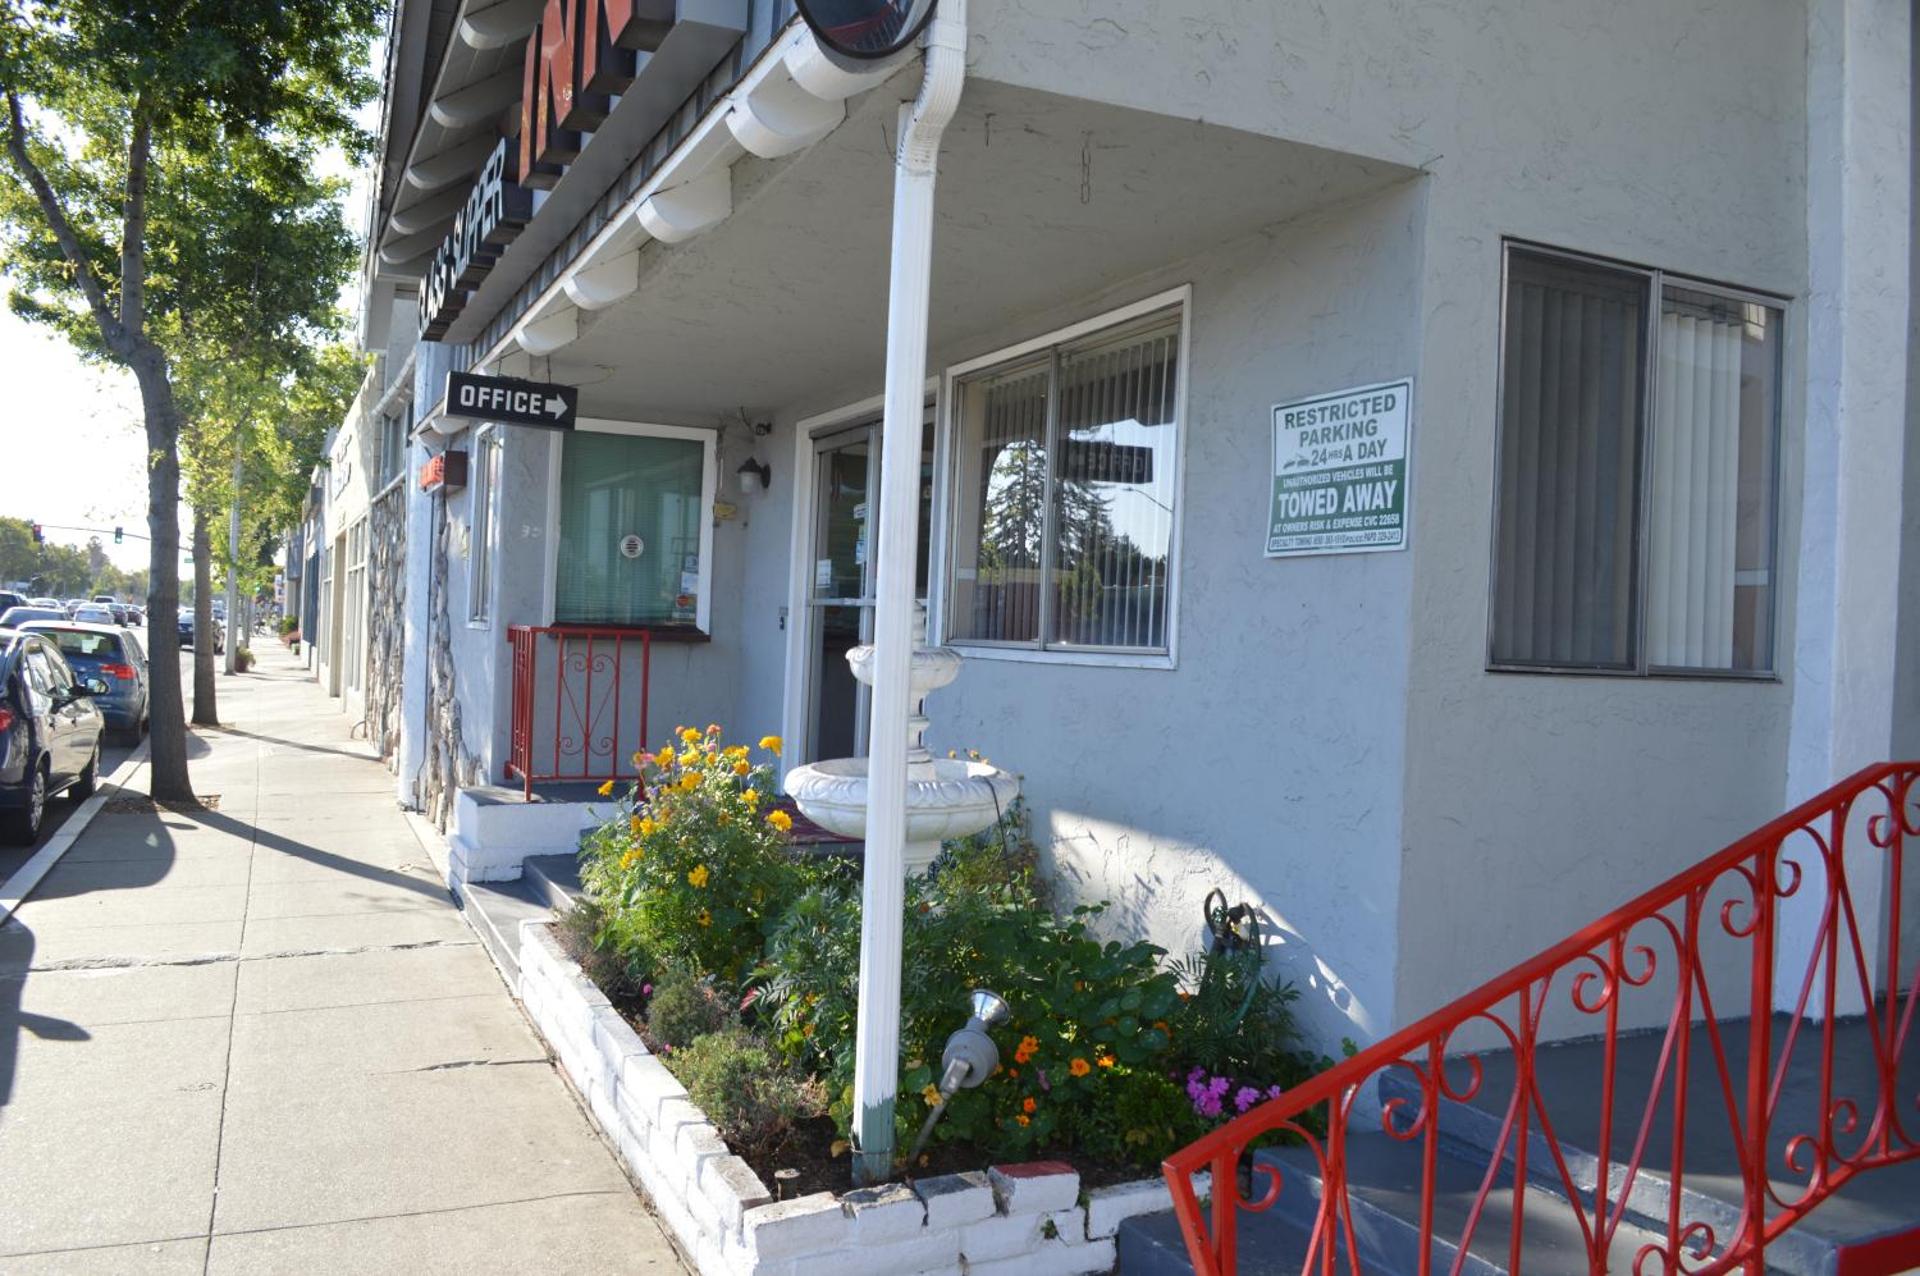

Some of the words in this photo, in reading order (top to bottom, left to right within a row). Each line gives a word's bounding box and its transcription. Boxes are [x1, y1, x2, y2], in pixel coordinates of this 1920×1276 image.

[451, 137, 506, 290] SLIPPER
[460, 385, 542, 415] OFFICE
[1284, 394, 1396, 430] RESTRICTED
[1299, 419, 1378, 448] PARKING
[1311, 448, 1328, 467] 24
[1328, 449, 1342, 460] HRS
[1343, 445, 1353, 462] A
[1358, 438, 1388, 459] DAY
[1283, 473, 1331, 489] UNAUTHORIZED
[1332, 468, 1364, 483] VEHICLES
[1365, 466, 1383, 479] WILL
[1384, 464, 1394, 476] BE
[1279, 488, 1338, 519] TOWED
[1343, 480, 1397, 513] AWAY
[1273, 523, 1282, 533] AT
[1309, 519, 1325, 531] RISK
[1325, 519, 1332, 530] &
[1332, 516, 1363, 530] EXPENSE
[1364, 515, 1378, 527] CVC
